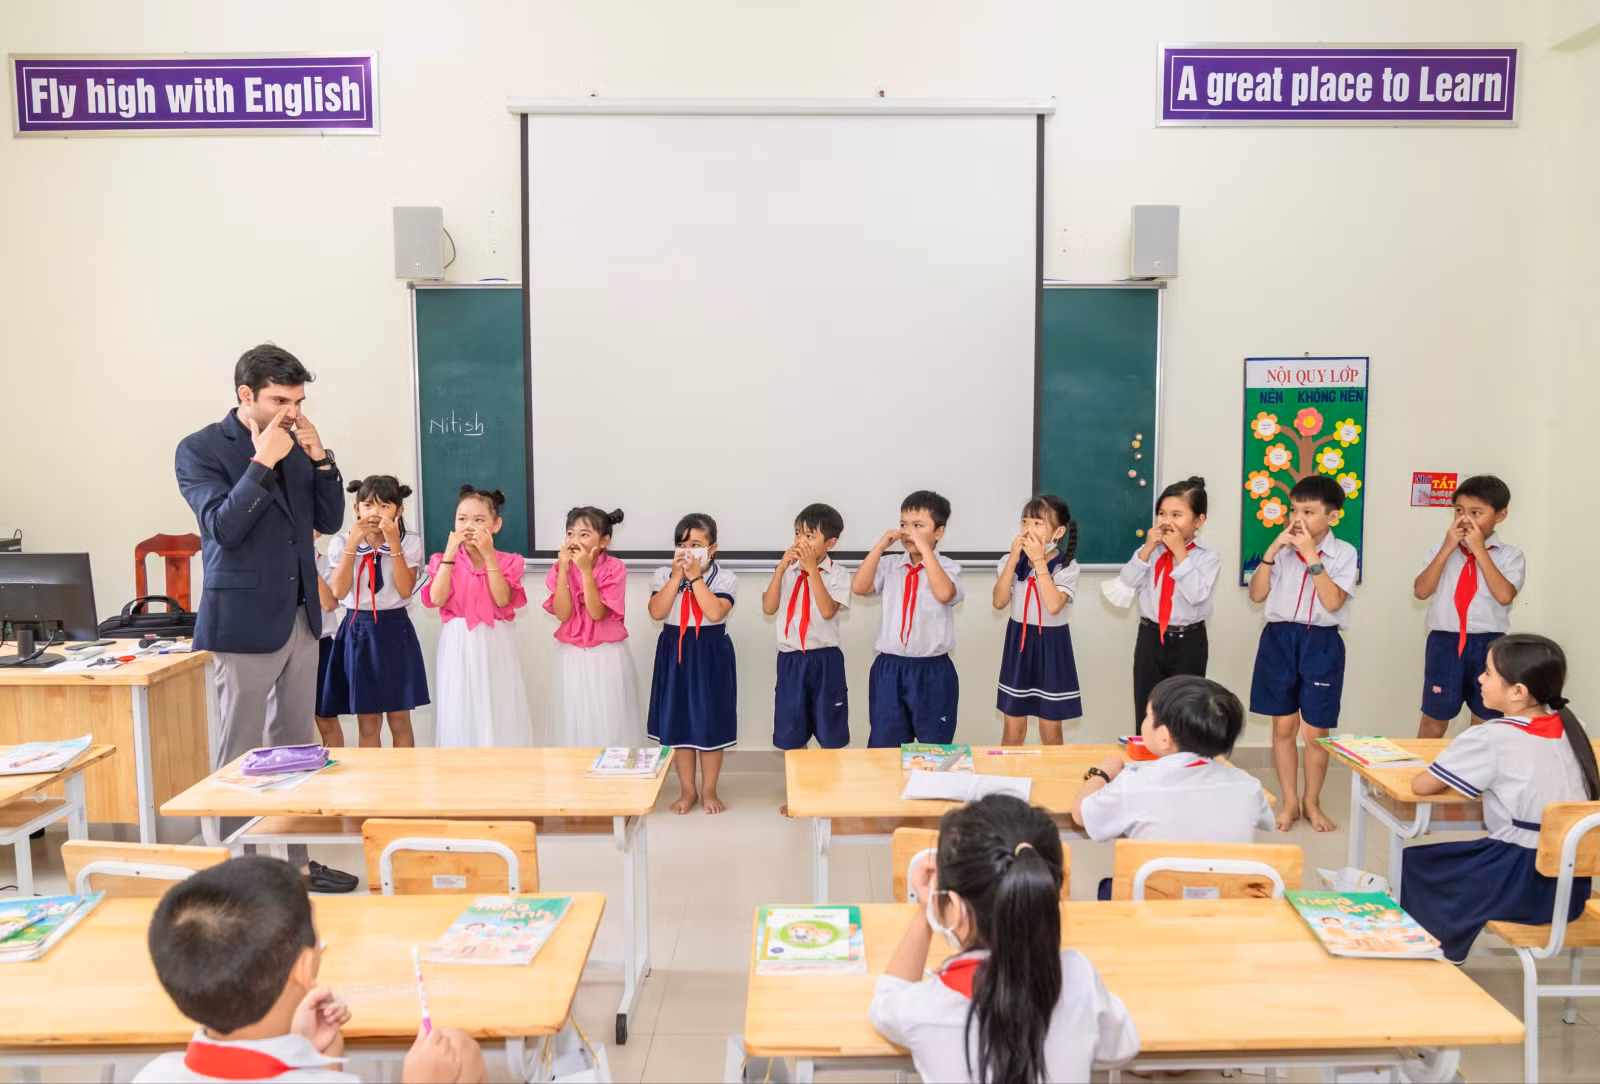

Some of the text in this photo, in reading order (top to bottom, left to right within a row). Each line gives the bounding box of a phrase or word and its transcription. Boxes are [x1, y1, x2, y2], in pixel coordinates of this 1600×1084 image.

[30, 76, 361, 118] Fly high with English
[1177, 65, 1502, 106] A great place to Learn
[1267, 365, 1359, 386] NỘI QUY LỚP
[1260, 386, 1364, 404] NÊN KHÔNG NÊN
[429, 409, 485, 436] Nitish
